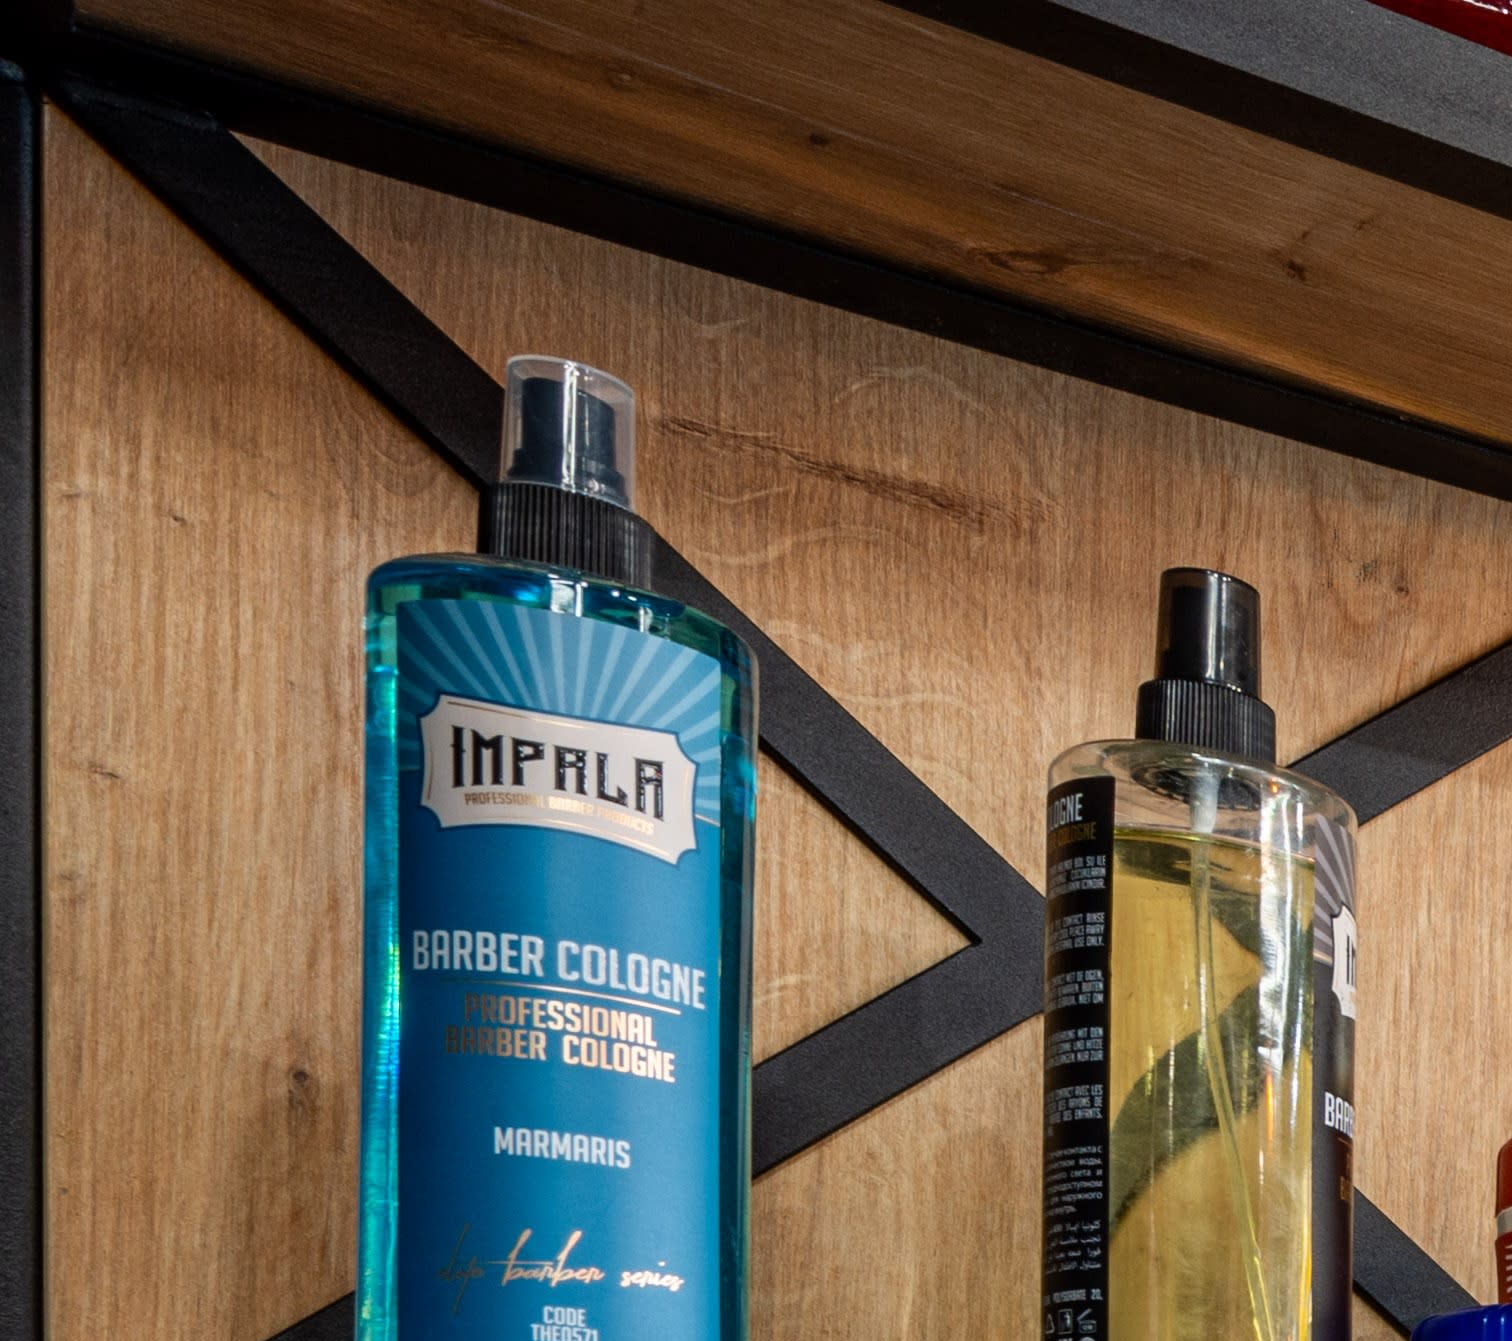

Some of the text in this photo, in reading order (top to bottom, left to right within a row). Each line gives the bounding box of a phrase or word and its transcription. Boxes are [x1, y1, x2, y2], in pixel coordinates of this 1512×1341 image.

[451, 725, 665, 822] IMPALA
[465, 792, 547, 810] PROFESSIONAL
[413, 929, 706, 1011] BARBER COLOGNE
[464, 992, 658, 1048] PROFESSIONAL
[446, 1024, 677, 1081] BARBER COLOGNE
[494, 1126, 632, 1169] MARMARIS
[543, 1305, 587, 1328] CODE
